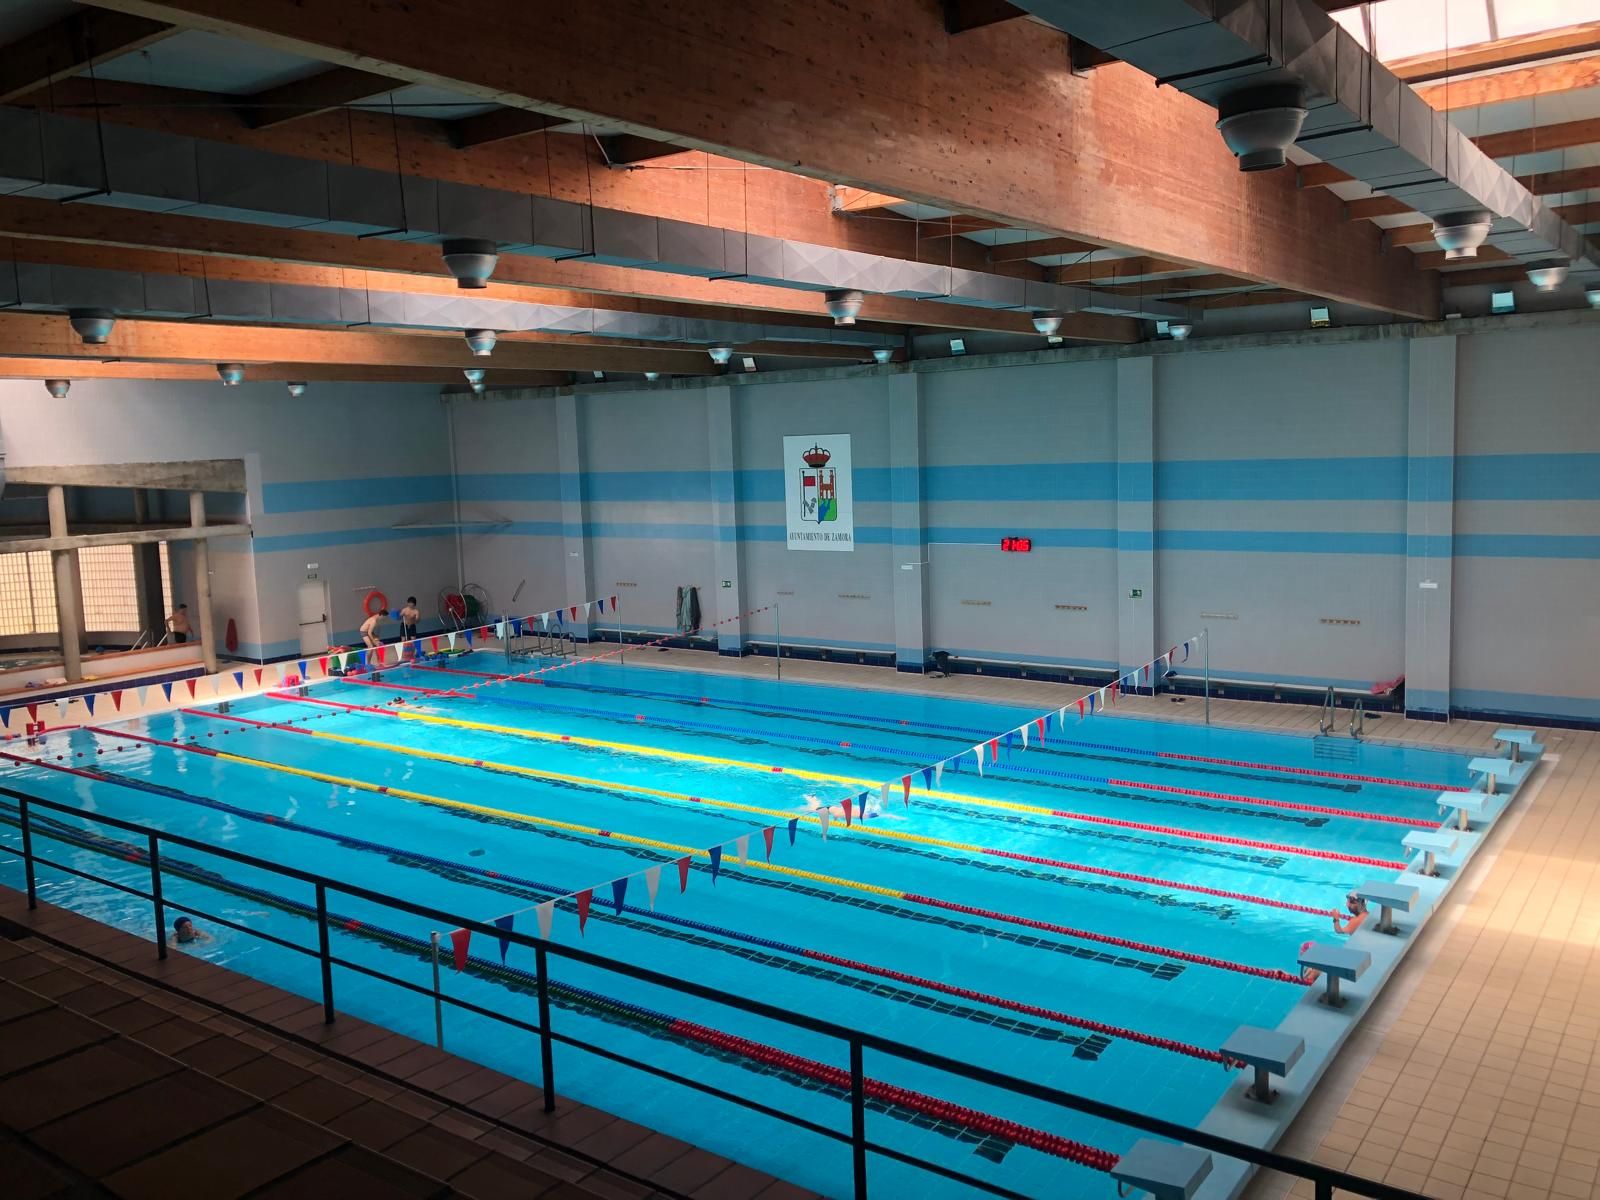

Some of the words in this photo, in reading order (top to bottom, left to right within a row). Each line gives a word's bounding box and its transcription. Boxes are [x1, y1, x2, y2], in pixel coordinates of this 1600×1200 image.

[789, 532, 823, 541] AYUNTAMIENTO
[824, 532, 831, 541] DE
[831, 532, 852, 542] ZAMORA
